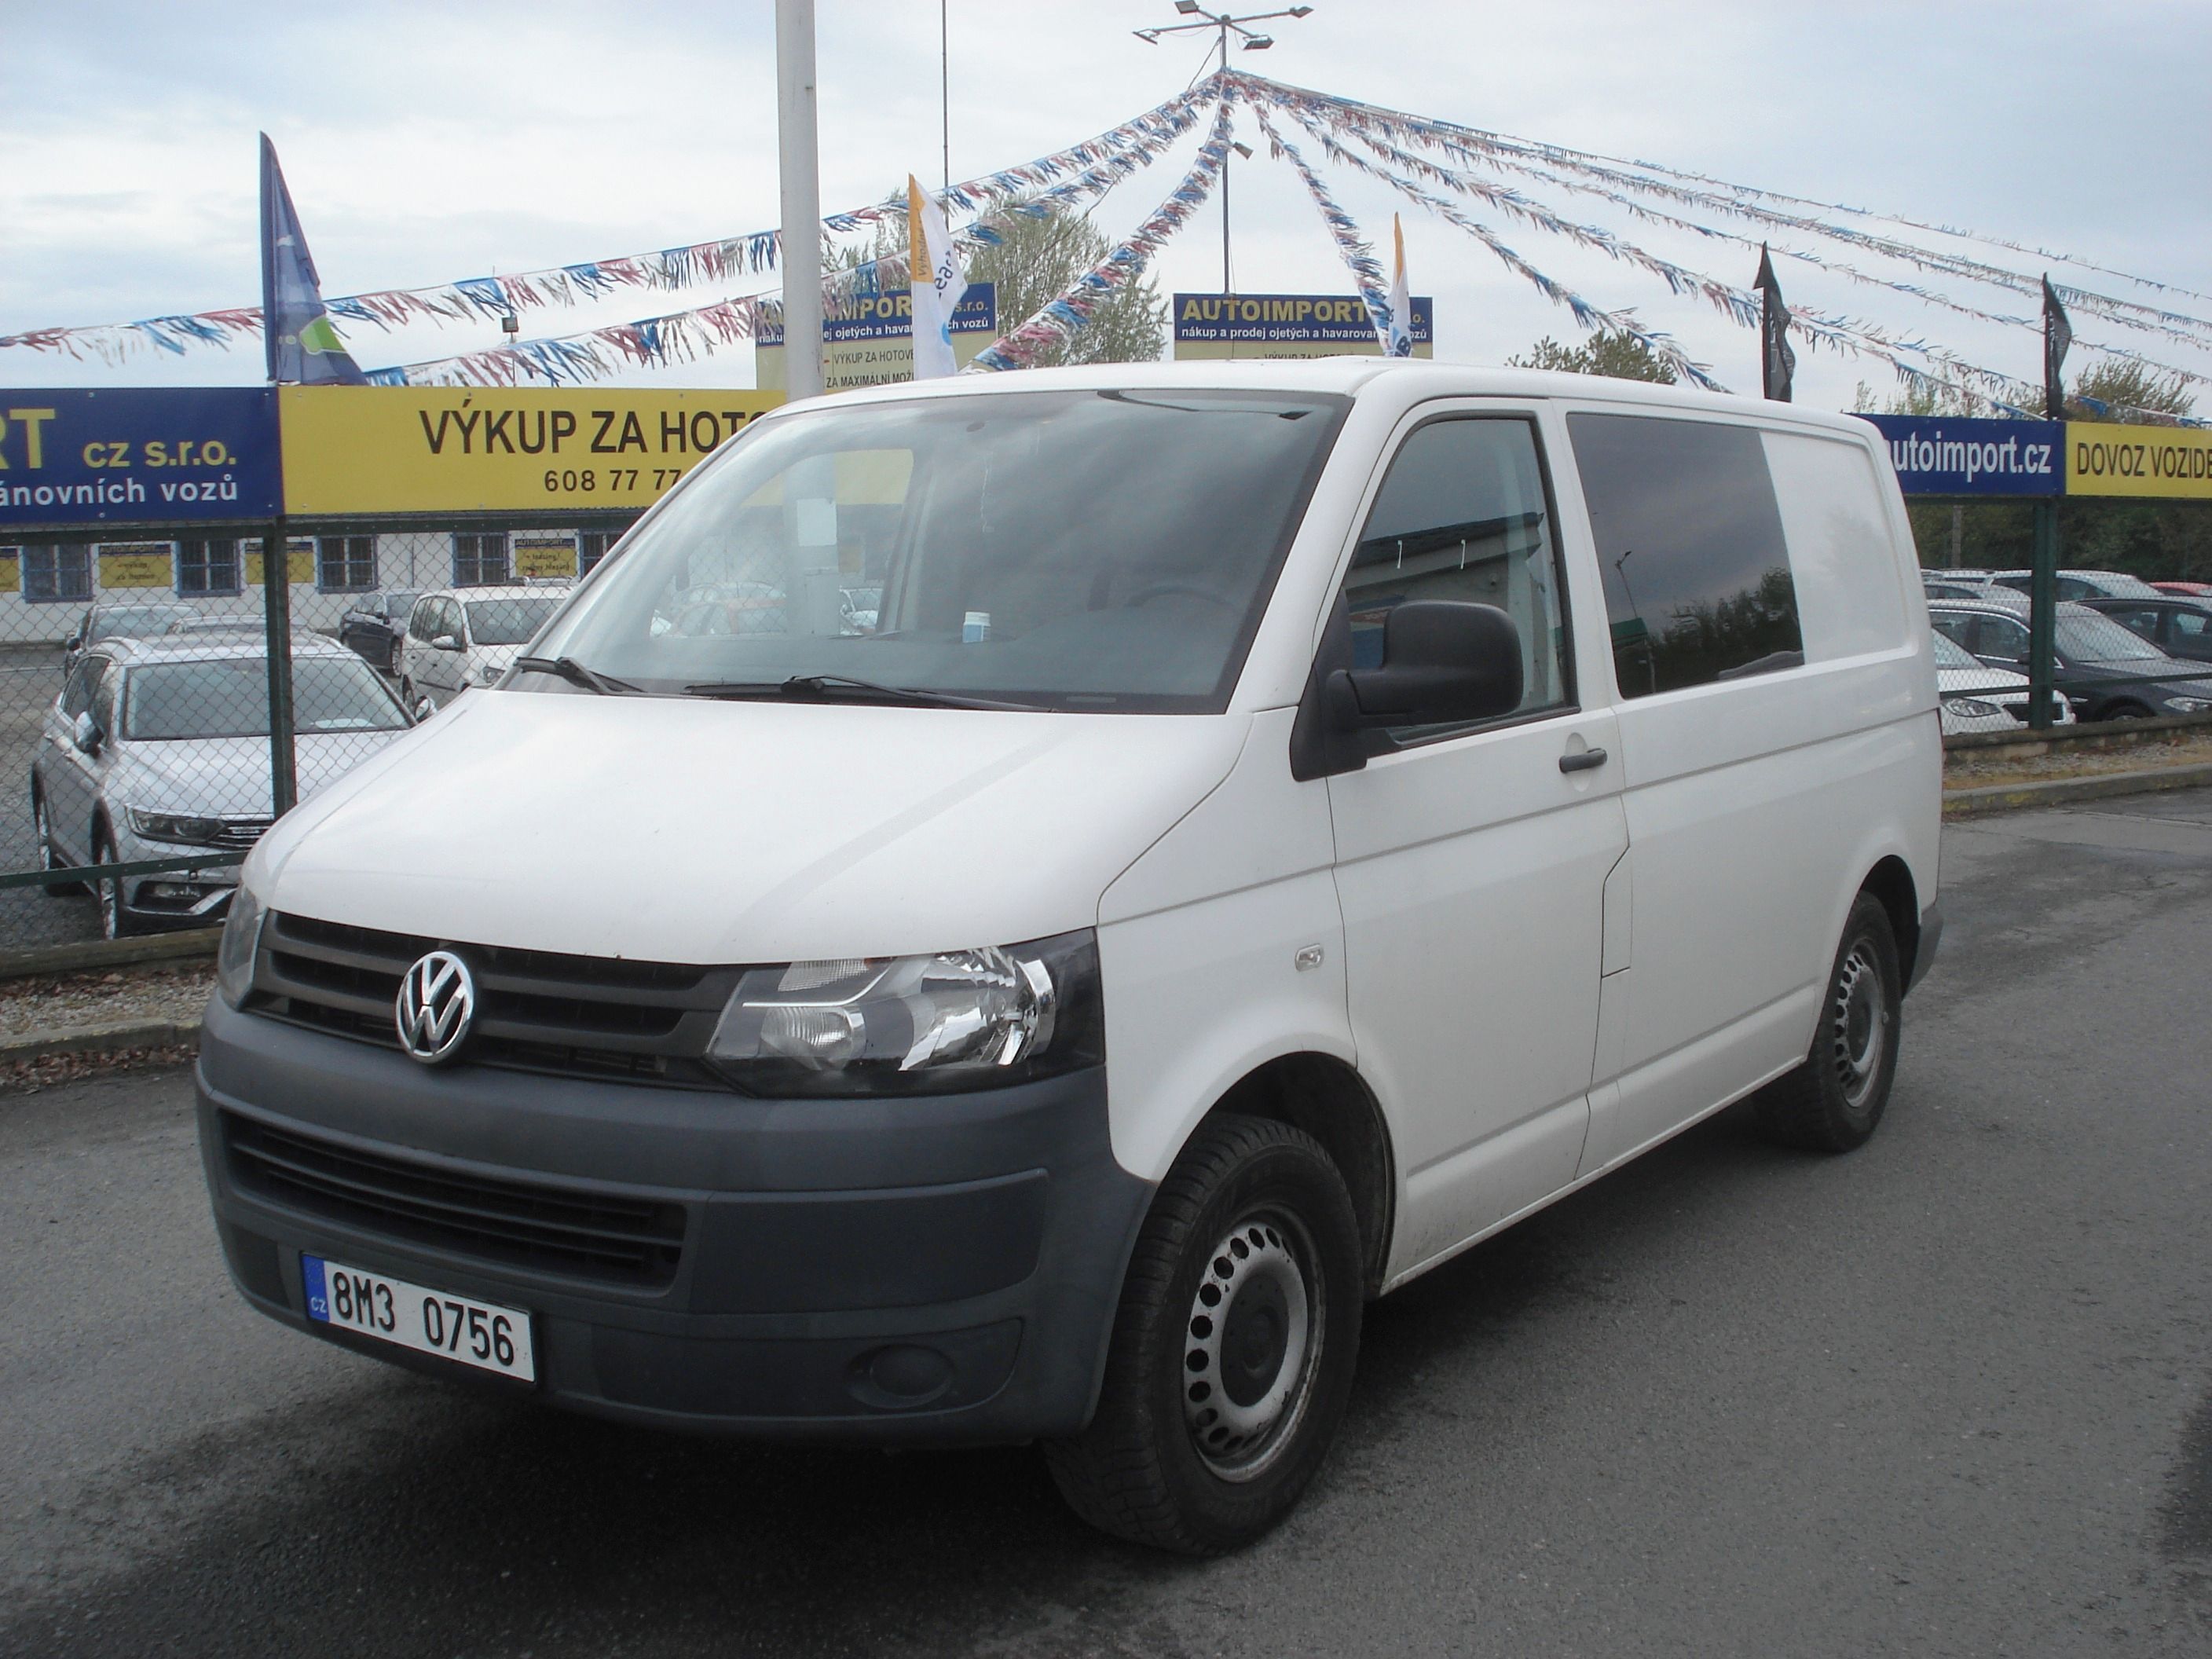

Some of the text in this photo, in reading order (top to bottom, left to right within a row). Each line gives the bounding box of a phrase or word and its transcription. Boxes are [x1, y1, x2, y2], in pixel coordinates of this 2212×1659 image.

[836, 325, 873, 341] ojetých
[962, 317, 988, 328] vozů
[1182, 326, 1217, 339] nákup
[1220, 328, 1226, 338] a
[1230, 327, 1265, 340] prodej
[1269, 327, 1309, 340] ojetých
[1313, 328, 1320, 338] a
[834, 350, 862, 364] VÝKUP
[866, 351, 877, 363] ZA
[826, 377, 838, 388] ZA
[840, 371, 890, 387] MAXIMÁLNÍ
[419, 398, 767, 454] VÝKUP ZA HOT
[83, 442, 130, 468] cz
[145, 441, 236, 467] s.r.o.
[2077, 442, 2144, 477] DOVOZ
[161, 474, 237, 502] vozů
[544, 471, 596, 491] 608
[610, 470, 639, 491] 77
[310, 1298, 328, 1313] CZ
[333, 1272, 515, 1366] 8M3 0756
